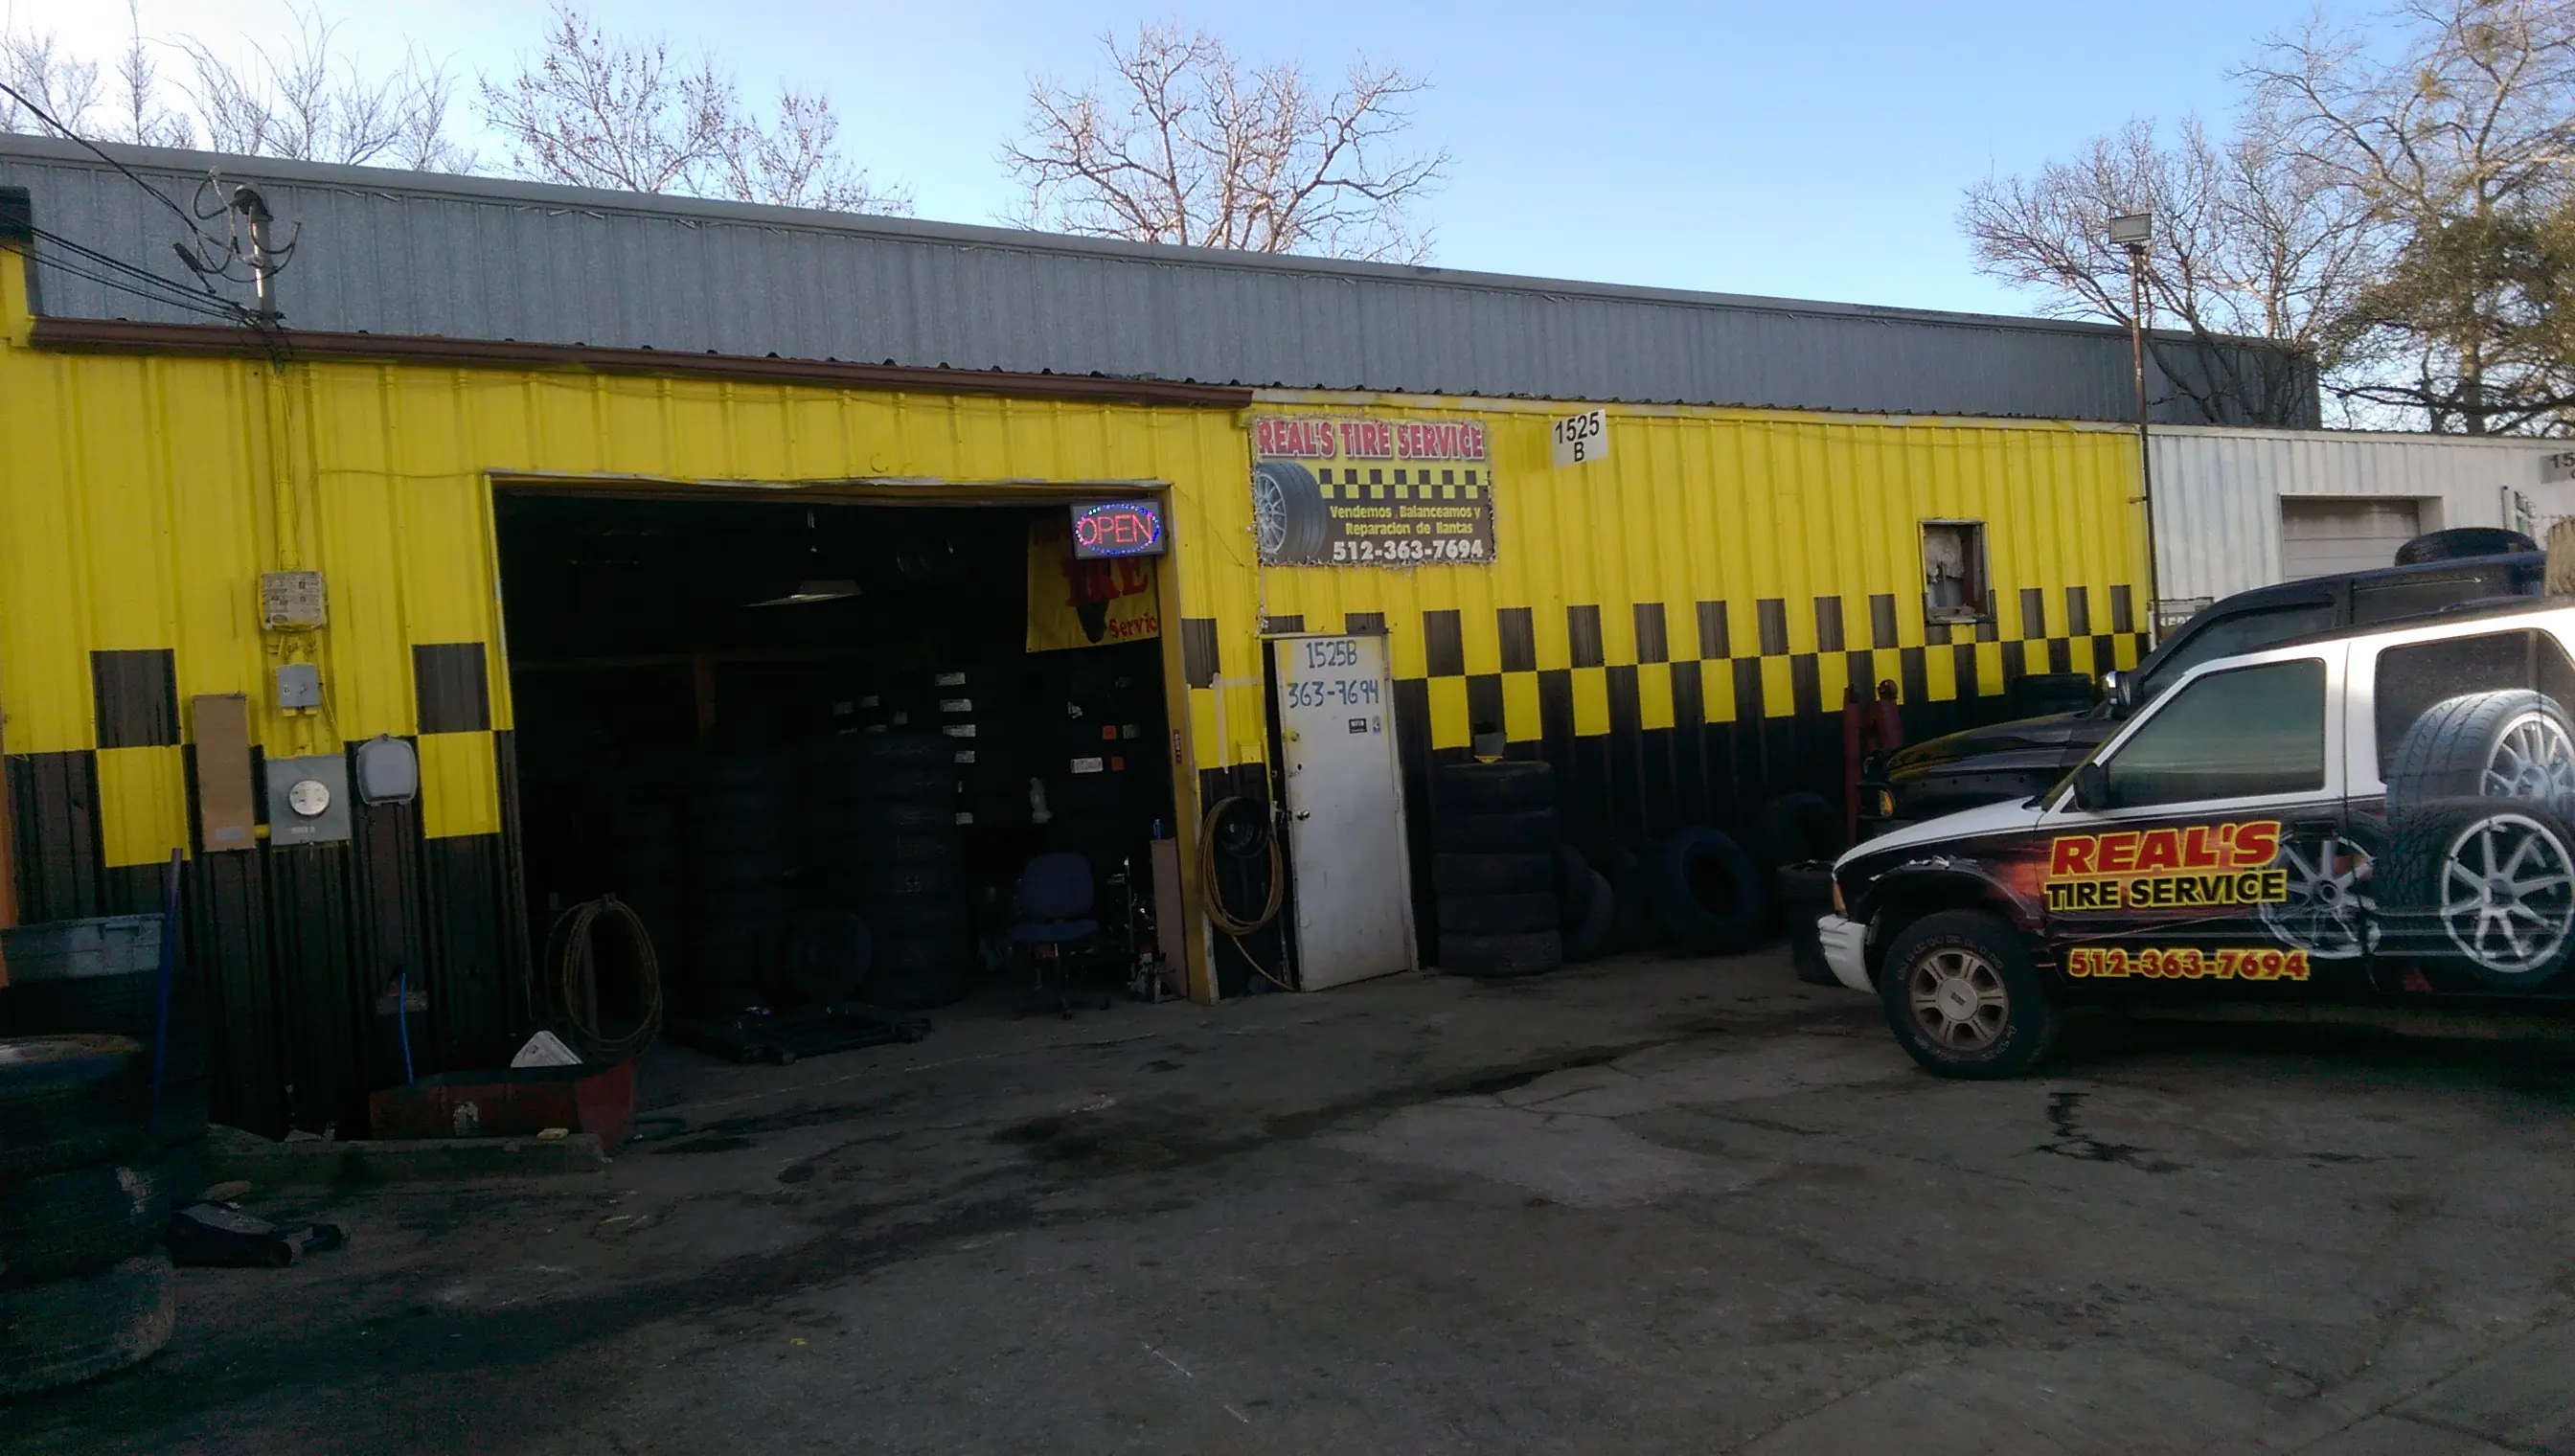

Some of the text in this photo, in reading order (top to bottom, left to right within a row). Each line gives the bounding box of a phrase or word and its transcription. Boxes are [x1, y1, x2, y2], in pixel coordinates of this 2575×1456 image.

[1256, 420, 1485, 460] REAL'S TIRE SERVICE
[1555, 411, 1600, 444] 1525
[1574, 441, 1585, 463] B
[1399, 505, 1472, 518] Balanceamos
[1473, 507, 1481, 520] y
[1079, 513, 1152, 545] OPEN
[1416, 521, 1431, 535] de
[1333, 539, 1484, 561] 512-363-7694
[1306, 640, 1357, 669] 1525B
[1288, 680, 1379, 709] 363-7694
[2050, 821, 2282, 877] REAL'S
[2044, 870, 2288, 910] TIRE SERVICE
[2069, 948, 2311, 981] 512-363-7694
